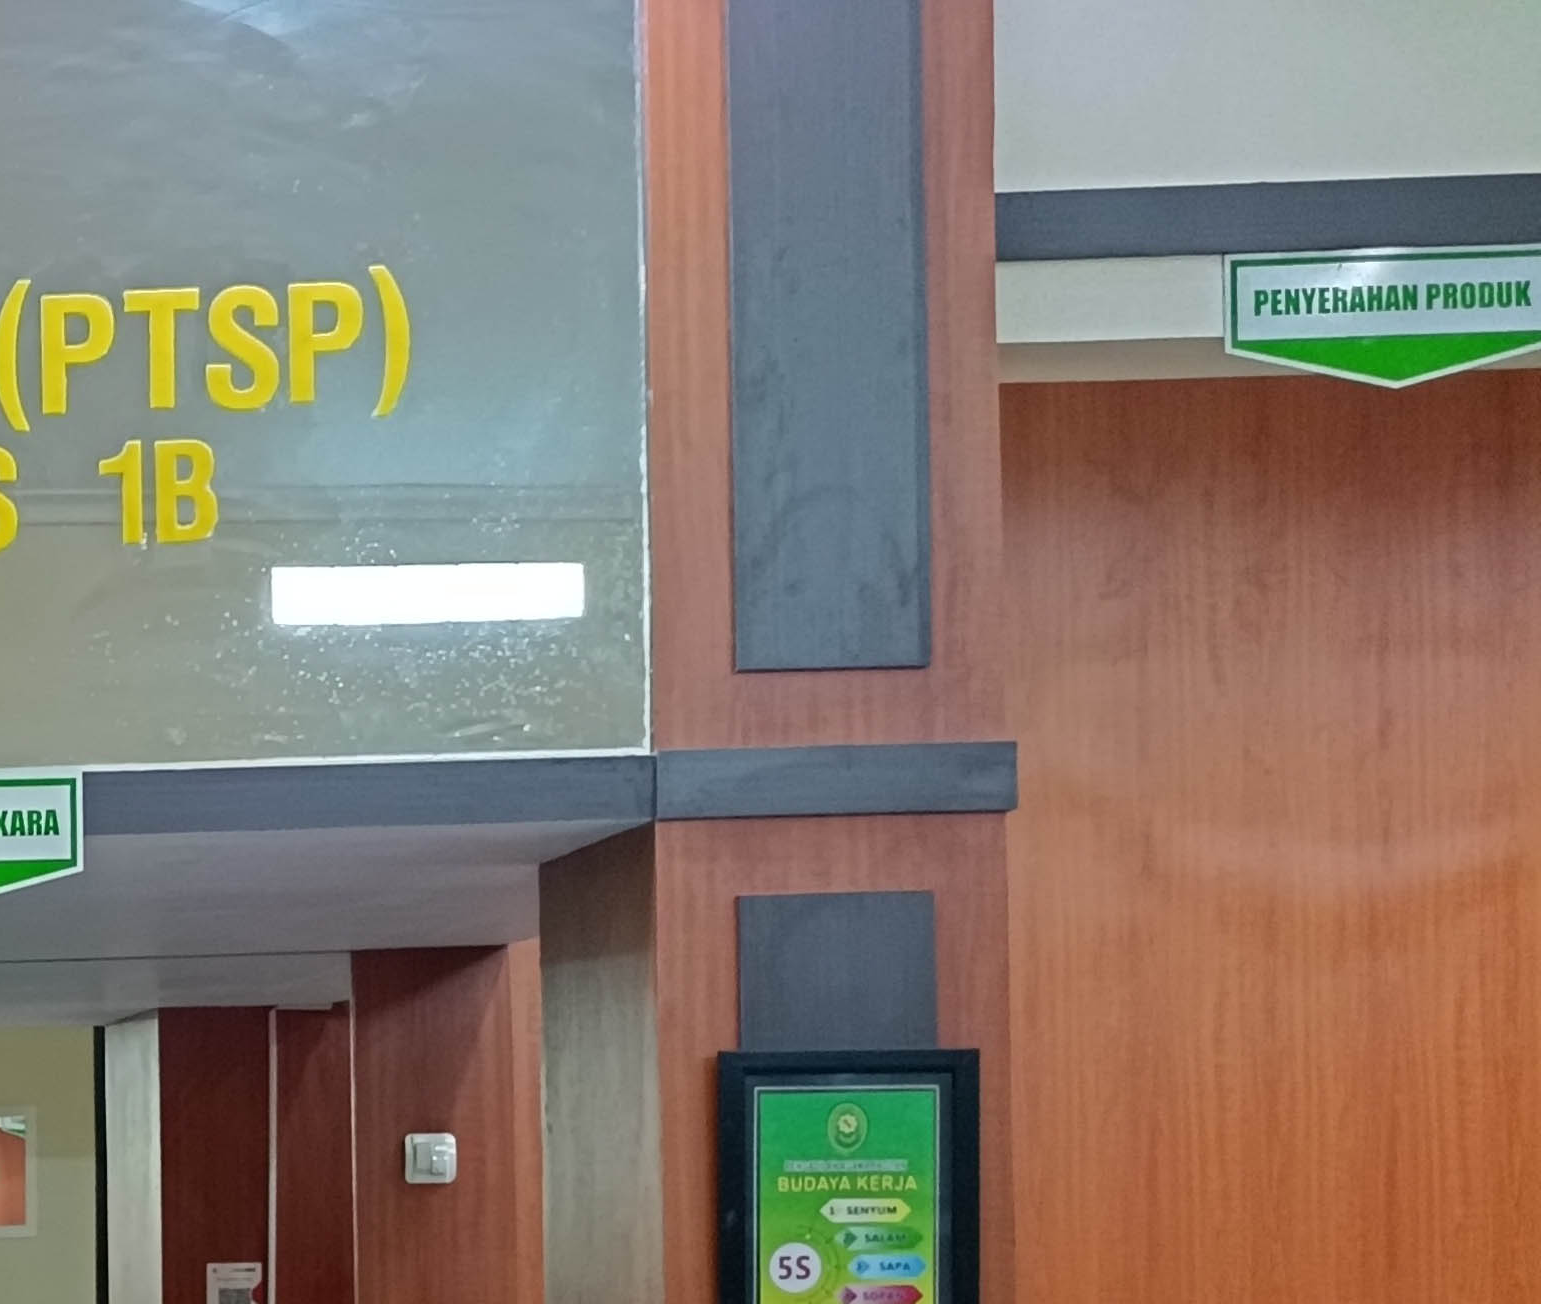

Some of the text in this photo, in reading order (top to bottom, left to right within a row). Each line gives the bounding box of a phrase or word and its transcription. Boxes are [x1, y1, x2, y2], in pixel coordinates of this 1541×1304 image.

[1254, 280, 1533, 316] PENYERAHAN PRODUK
[98, 438, 220, 548] 1B
[777, 1174, 918, 1192] BUDAYA KERJA
[846, 1205, 898, 1215] SENYUM
[864, 1233, 906, 1243] SALAM
[778, 1255, 811, 1280] 5S
[879, 1261, 911, 1271] SAPA
[863, 1290, 903, 1300] SOPAN
